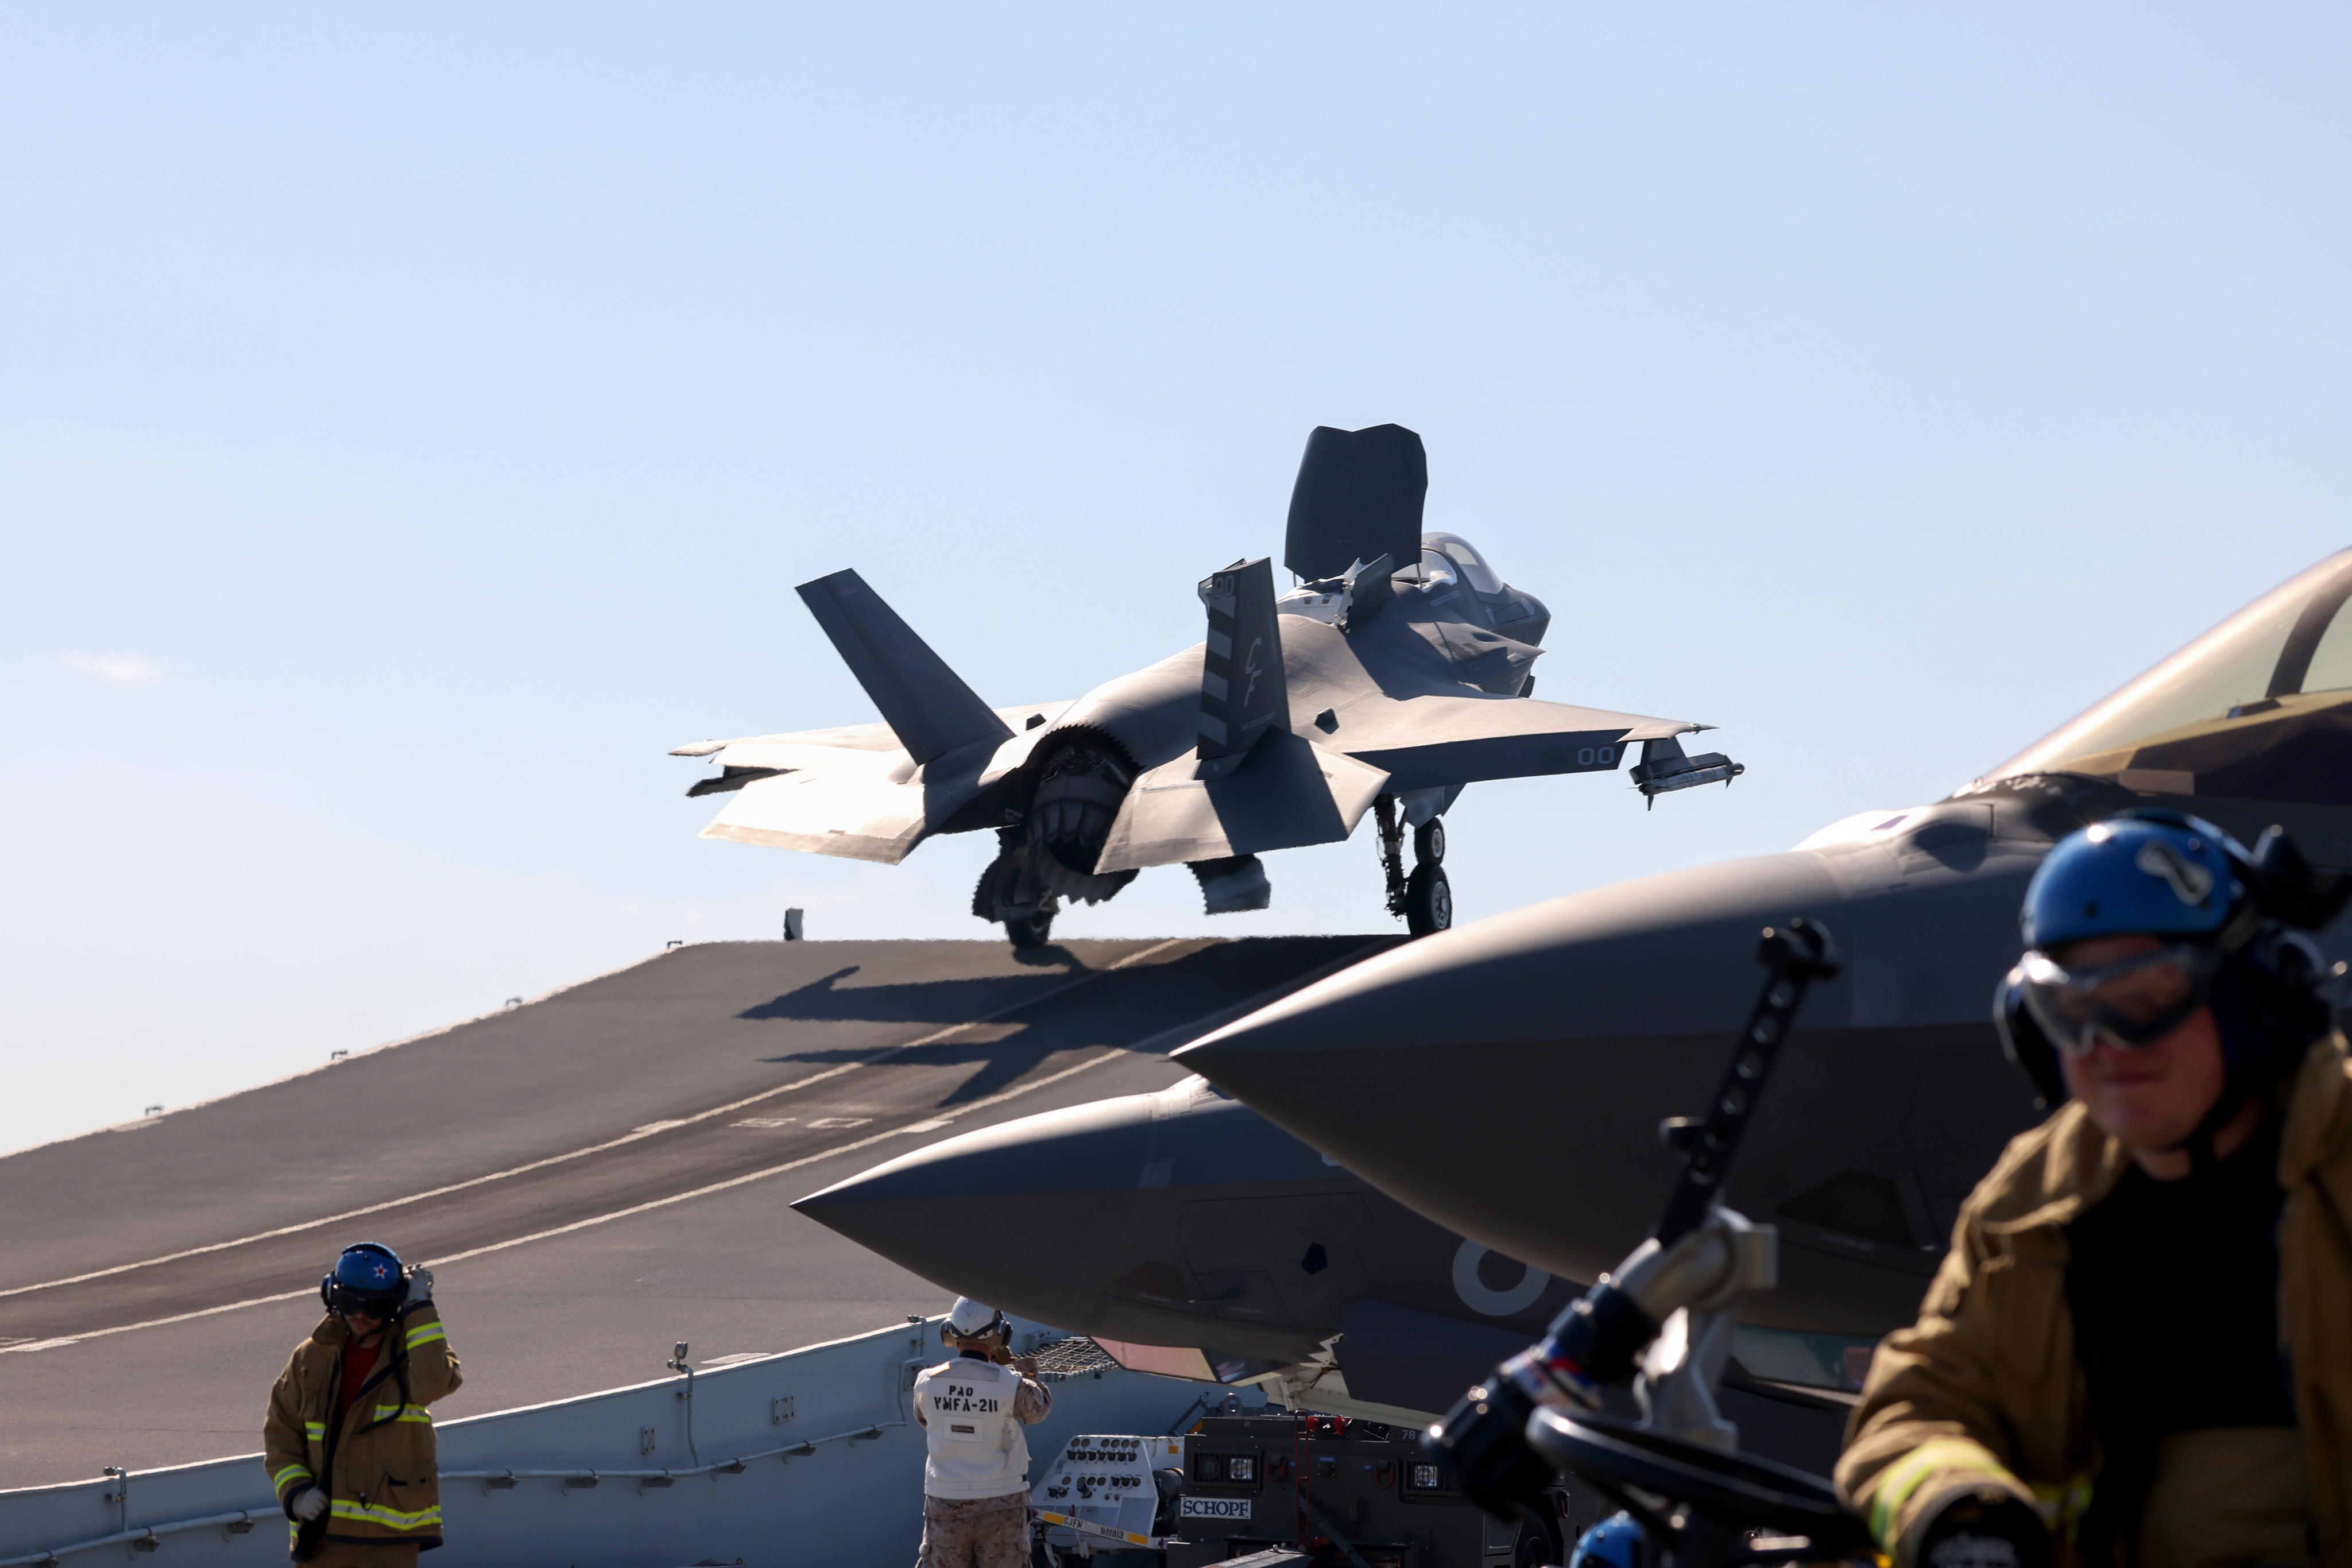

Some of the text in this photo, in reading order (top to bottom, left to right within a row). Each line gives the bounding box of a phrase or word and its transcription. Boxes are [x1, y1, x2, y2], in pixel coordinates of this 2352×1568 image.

[1577, 746, 1615, 765] 00
[949, 1385, 973, 1397] PAO
[934, 1396, 998, 1412] VMFA-211
[1183, 1500, 1248, 1516] SCHOPF
